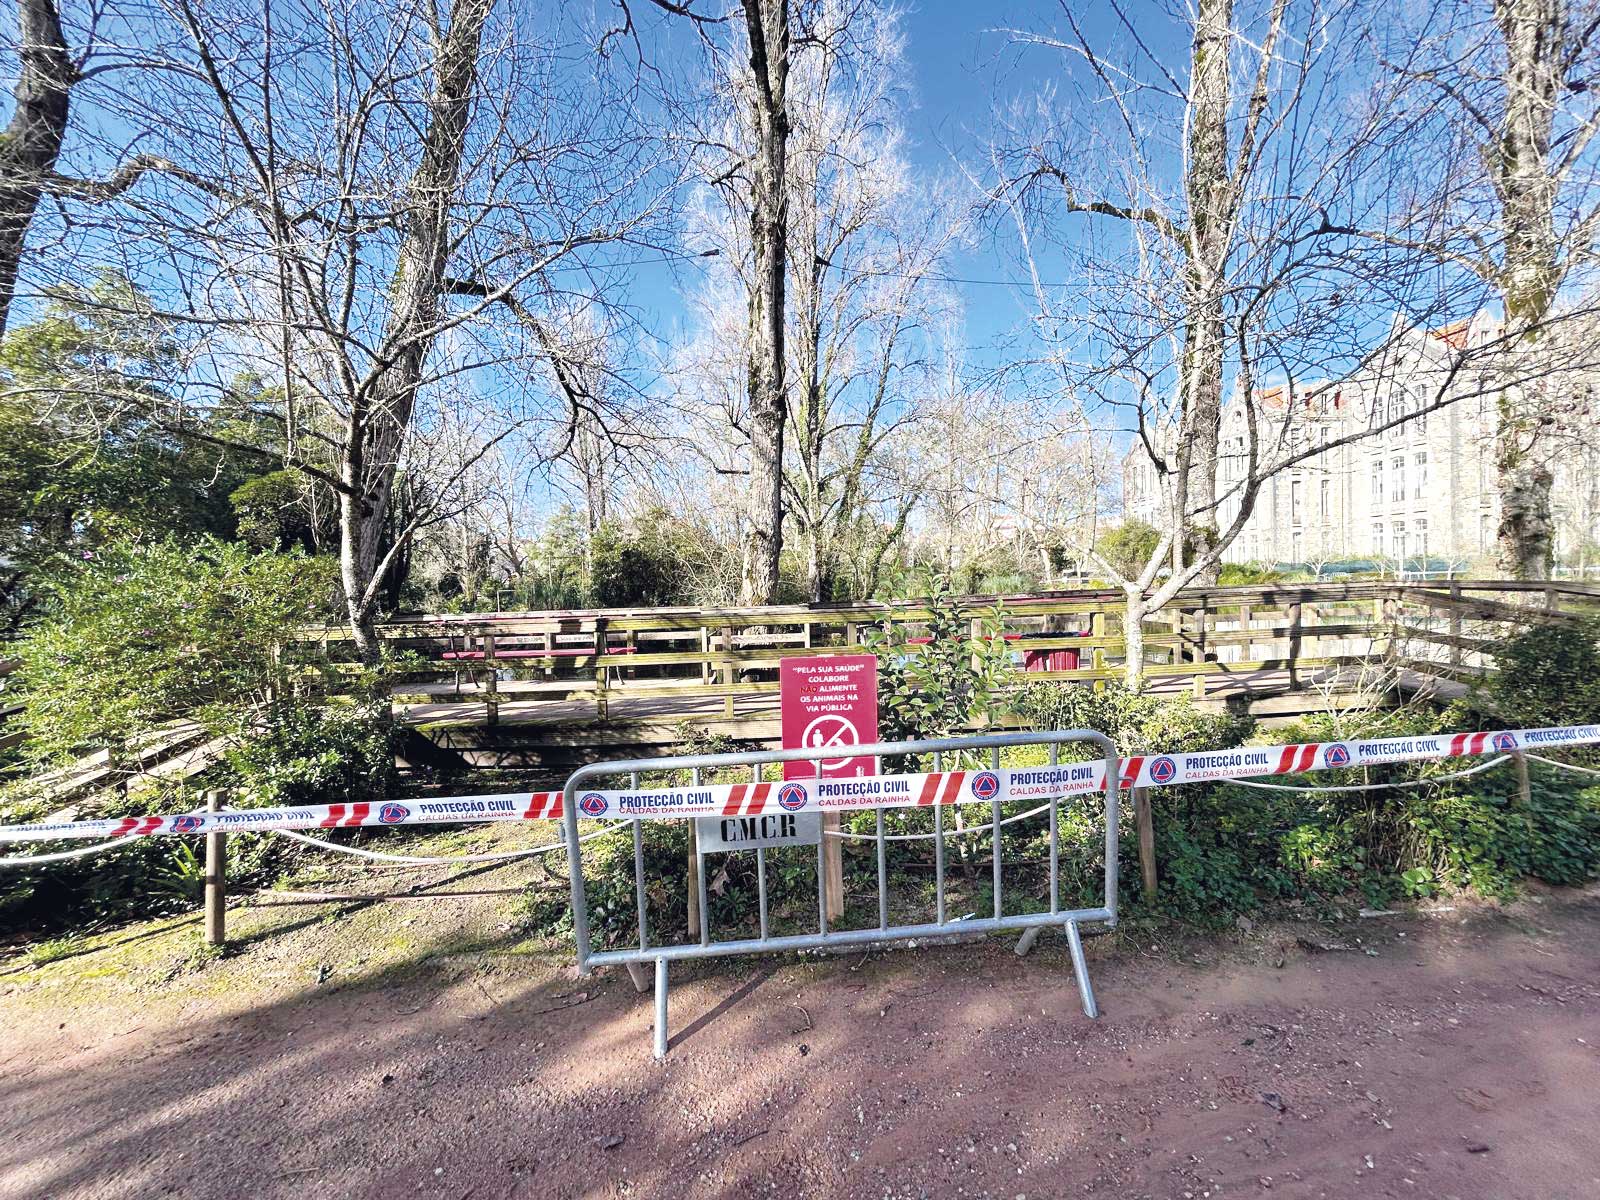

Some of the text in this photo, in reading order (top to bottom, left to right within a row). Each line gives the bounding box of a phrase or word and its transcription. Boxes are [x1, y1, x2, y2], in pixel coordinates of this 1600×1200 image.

[808, 675, 849, 683] COLABORE
[819, 684, 857, 692] ALIMENTE
[813, 694, 845, 702] ANIMAIS
[820, 703, 852, 711] PÚBLICA
[1416, 740, 1440, 752] CIVIL
[1186, 753, 1269, 770] PROTECÇÃO CIVIL
[1010, 767, 1094, 785] PROTECÇÃO CIVIL
[1185, 767, 1268, 779] CALDAS DA RAINHA
[818, 780, 910, 796] PROTECÇÃO CIVIL
[1010, 781, 1094, 796] CALDAS DA RAINHA
[619, 791, 684, 807] PROTECÇÃO
[687, 792, 714, 805] CIVIL
[818, 795, 910, 807] CALDAS DA RAINHA
[419, 800, 485, 814] PROTECÇÃO
[488, 800, 516, 812] CIVIL
[619, 807, 658, 815] CALDAS
